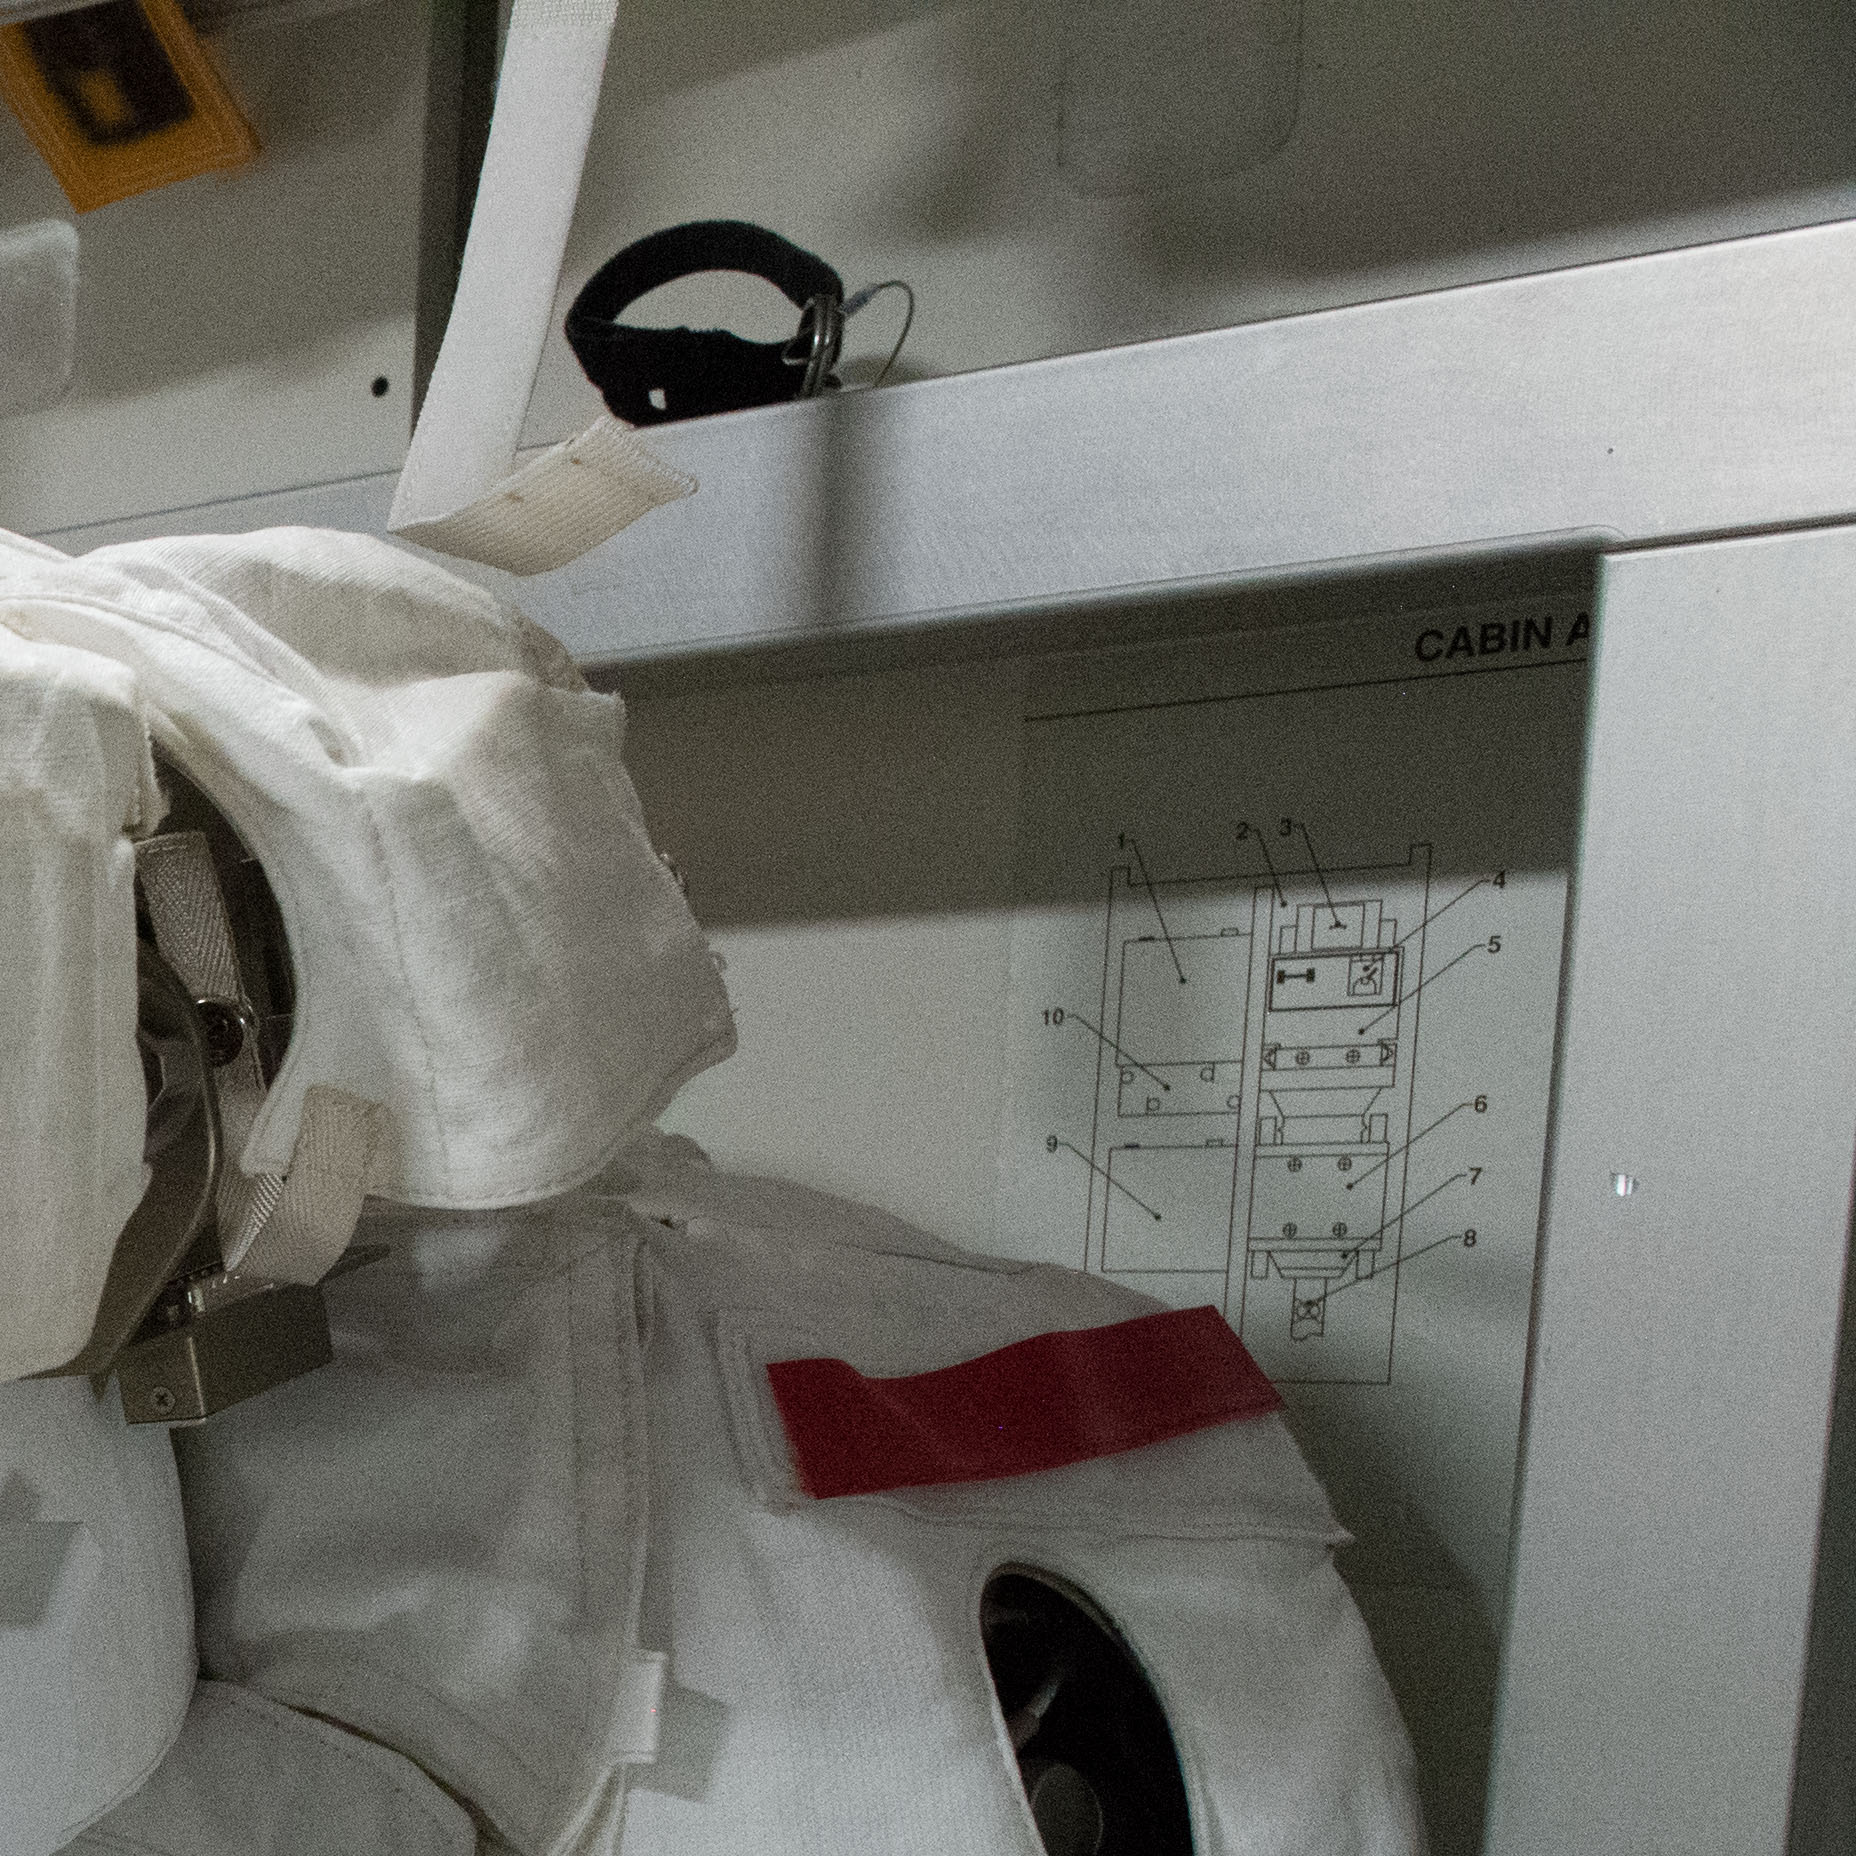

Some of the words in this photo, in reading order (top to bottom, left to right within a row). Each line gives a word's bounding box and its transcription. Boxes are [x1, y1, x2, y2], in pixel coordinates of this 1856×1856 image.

[1414, 615, 1553, 662] CABIN
[1236, 821, 1249, 841] 2
[1279, 817, 1293, 837] 3
[1117, 831, 1126, 851] 1
[1492, 869, 1507, 889] 4
[1487, 935, 1502, 954] 5
[1041, 1007, 1065, 1026] 10
[1474, 1094, 1488, 1114] 6
[1046, 1135, 1058, 1154] 9
[1469, 1166, 1483, 1186] 7
[1463, 1228, 1477, 1248] 8
